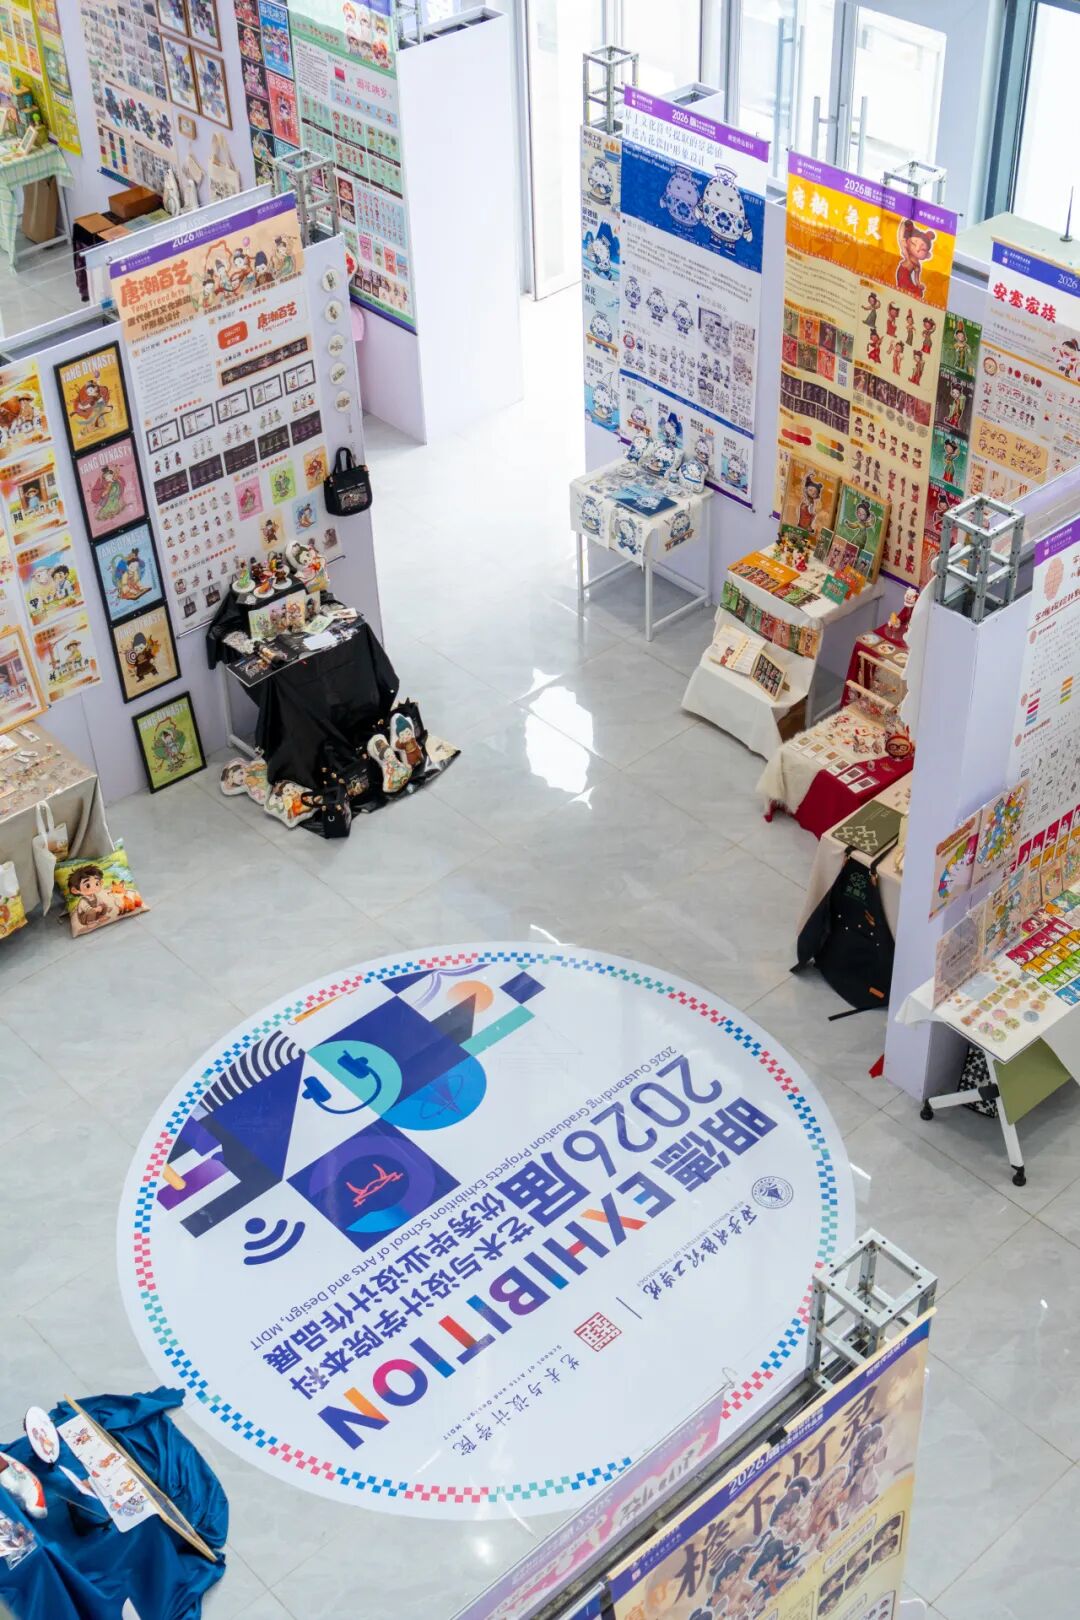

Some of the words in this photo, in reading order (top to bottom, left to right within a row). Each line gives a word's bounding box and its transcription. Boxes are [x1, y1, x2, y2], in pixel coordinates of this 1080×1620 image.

[120, 260, 192, 304] 唐潮百艺
[255, 301, 298, 329] 唐潮百艺
[993, 282, 1057, 324] 安塞家族
[82, 354, 116, 375] DYNASTY
[98, 446, 132, 468] DYNASTY
[651, 1045, 676, 1068] 2026
[585, 1063, 651, 1112] Outstanding
[494, 1055, 722, 1227] 2026届
[531, 1105, 590, 1152] Graduation
[650, 1096, 778, 1193] 明德
[484, 1146, 532, 1183] Projects
[429, 1178, 488, 1223] Exhibition
[389, 1217, 432, 1252] School
[351, 1255, 378, 1279] Arts
[375, 1246, 391, 1262] of
[261, 1191, 507, 1376] 优秀毕业设计作品展
[326, 1272, 353, 1297] and
[279, 1290, 329, 1328] Design,
[286, 1214, 535, 1400] 艺术与设计学院本科
[317, 1174, 676, 1449] EXHIBITION
[248, 1322, 282, 1351] MDIT
[535, 1344, 562, 1365] School
[493, 1387, 506, 1399] and
[508, 1372, 526, 1388] Arts
[451, 1354, 580, 1457] 艺术与设计学院
[675, 1387, 887, 1604] 檐下灯灵
